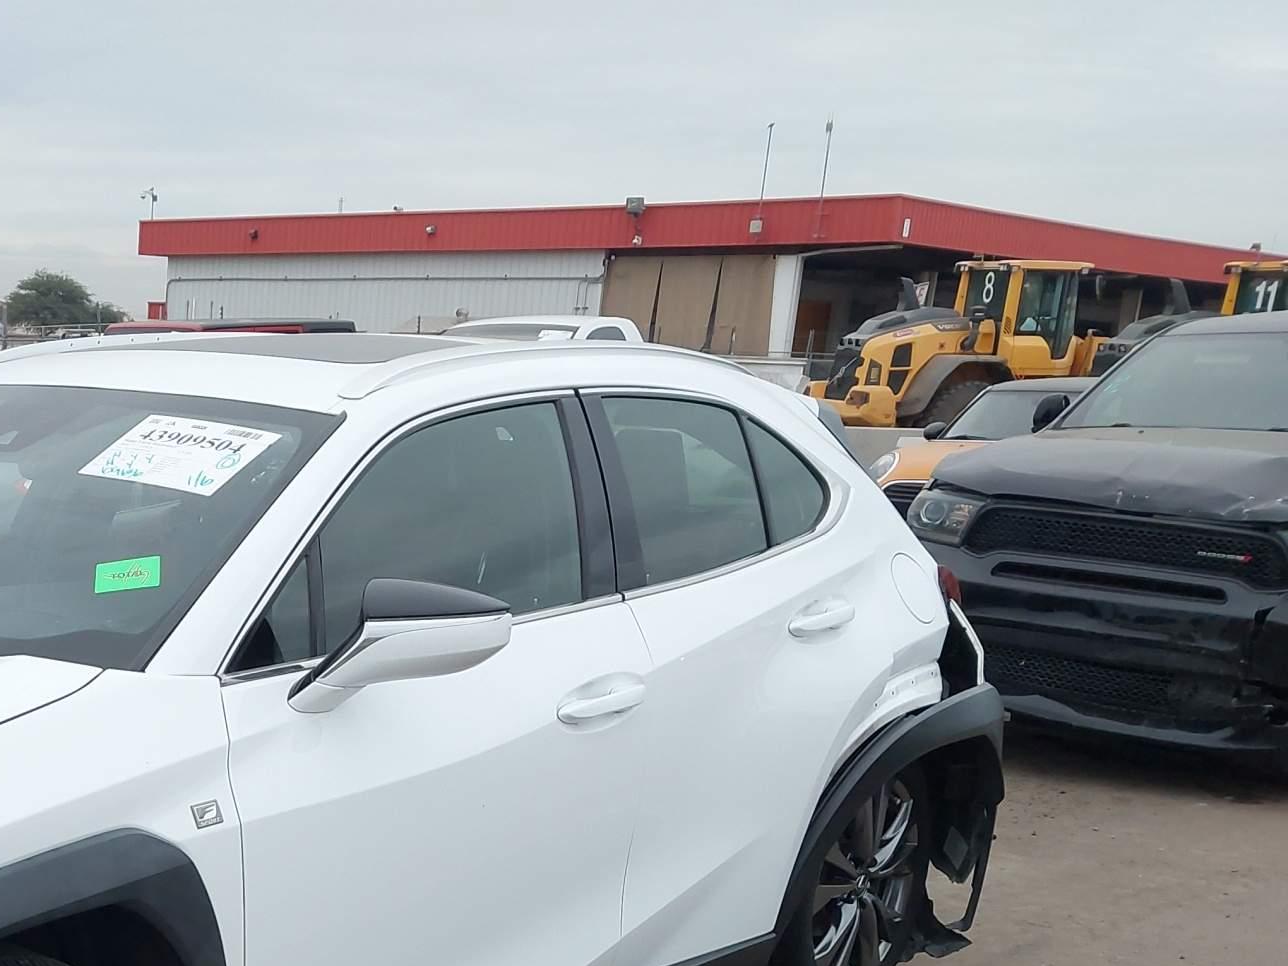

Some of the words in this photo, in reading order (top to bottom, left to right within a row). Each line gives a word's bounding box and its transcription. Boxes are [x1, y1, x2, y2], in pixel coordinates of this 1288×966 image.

[982, 271, 996, 304] 8
[1255, 280, 1279, 313] 11
[140, 428, 247, 454] 43909504
